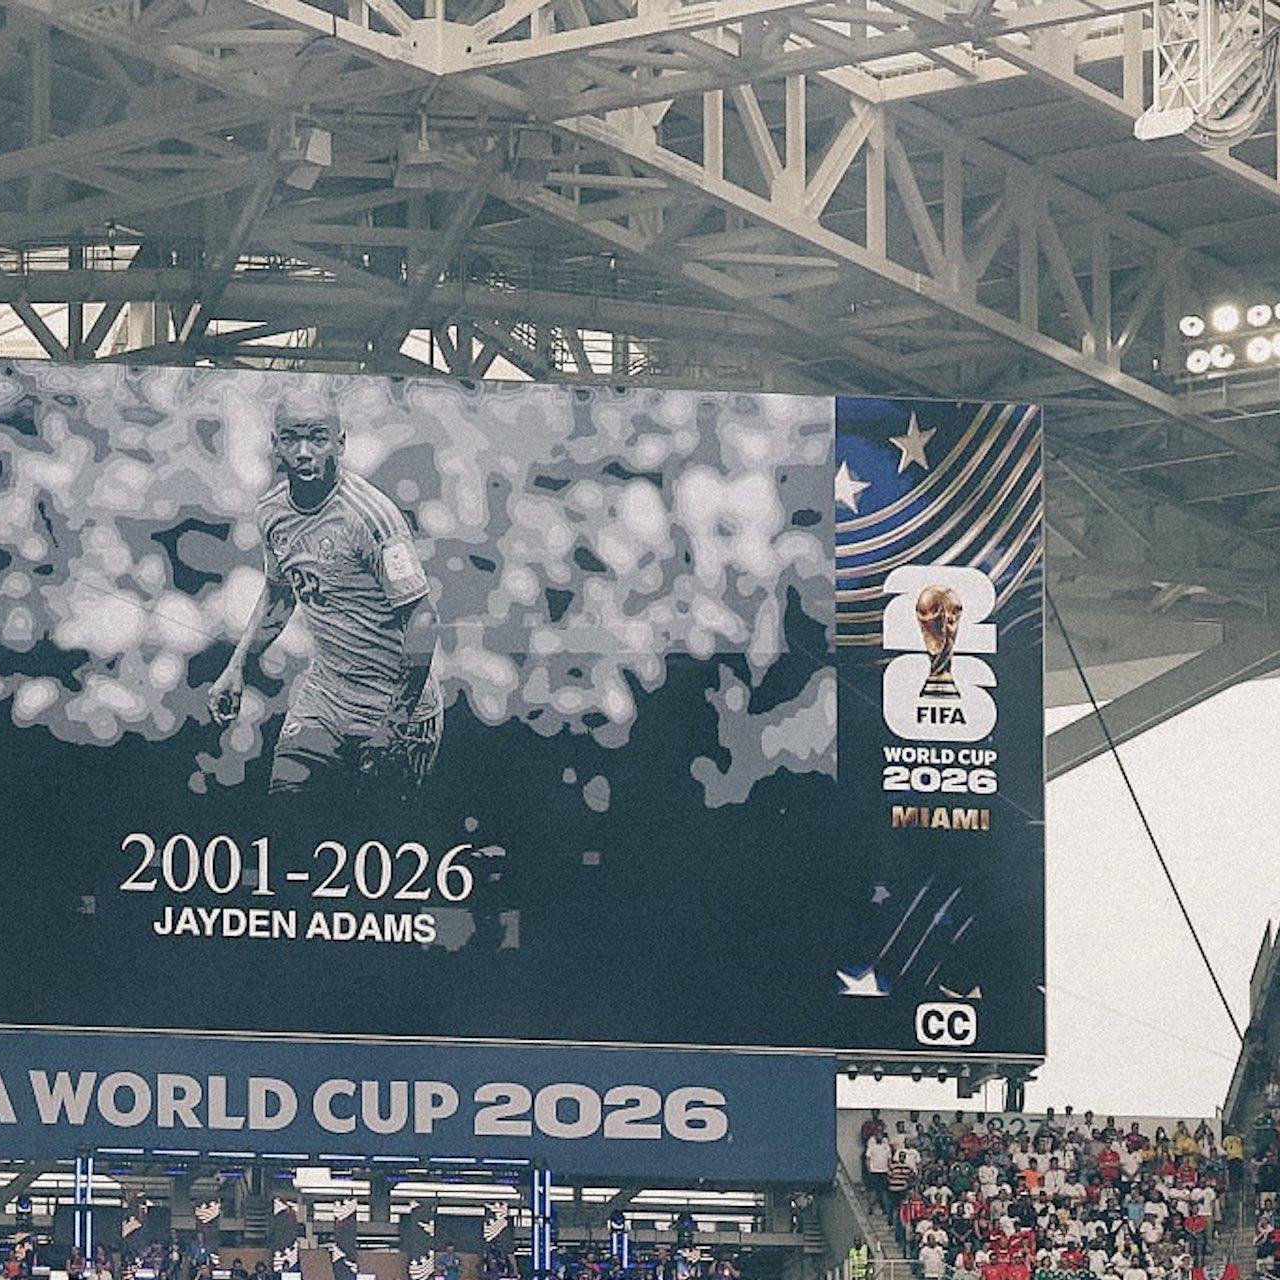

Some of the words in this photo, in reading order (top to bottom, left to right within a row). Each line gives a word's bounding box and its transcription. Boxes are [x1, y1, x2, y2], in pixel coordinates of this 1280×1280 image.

[916, 705, 966, 726] FIFA
[883, 746, 954, 765] WORLD
[958, 748, 997, 766] CUP
[883, 767, 998, 793] 2026
[891, 806, 990, 831] MIAMI
[120, 832, 476, 902] 2001-2026
[152, 907, 297, 939] JAYDEN
[306, 911, 437, 942] ADAMS
[921, 1009, 971, 1041] CC
[28, 1070, 298, 1130] WORLD
[313, 1078, 460, 1135] CUP
[473, 1082, 729, 1142] 2026
